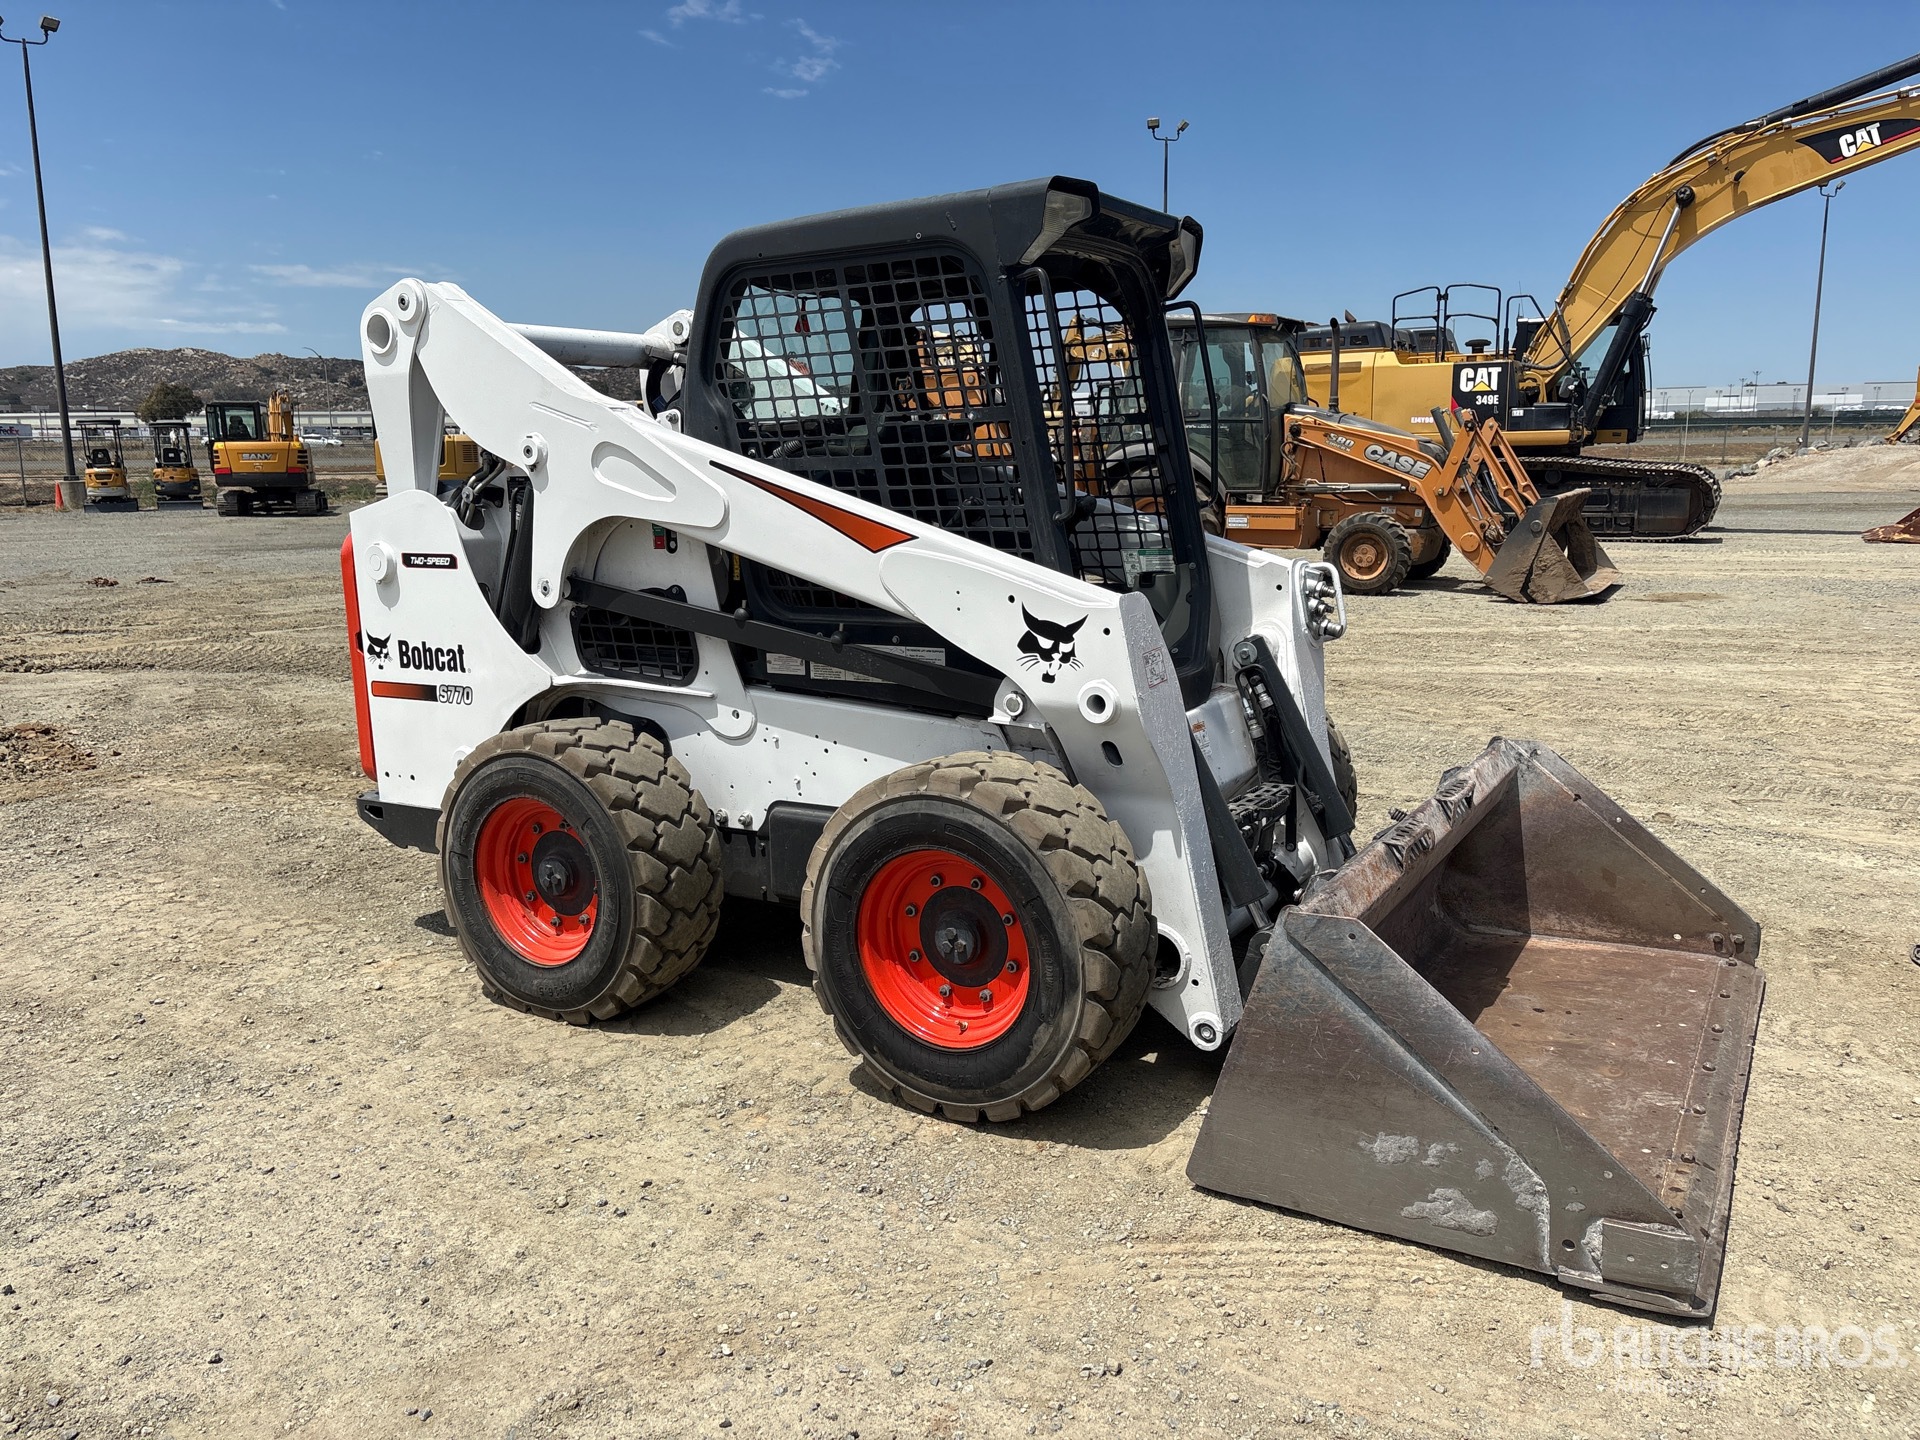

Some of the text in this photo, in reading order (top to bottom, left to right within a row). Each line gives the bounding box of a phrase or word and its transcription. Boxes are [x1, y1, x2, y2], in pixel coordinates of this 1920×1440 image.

[1839, 122, 1881, 157] CAT
[1459, 367, 1502, 392] CAT
[1475, 395, 1499, 405] 349E
[1364, 444, 1433, 480] CASE
[410, 556, 451, 566] TWO-SPEED
[398, 639, 467, 673] Bobcat
[438, 684, 473, 705] S770
